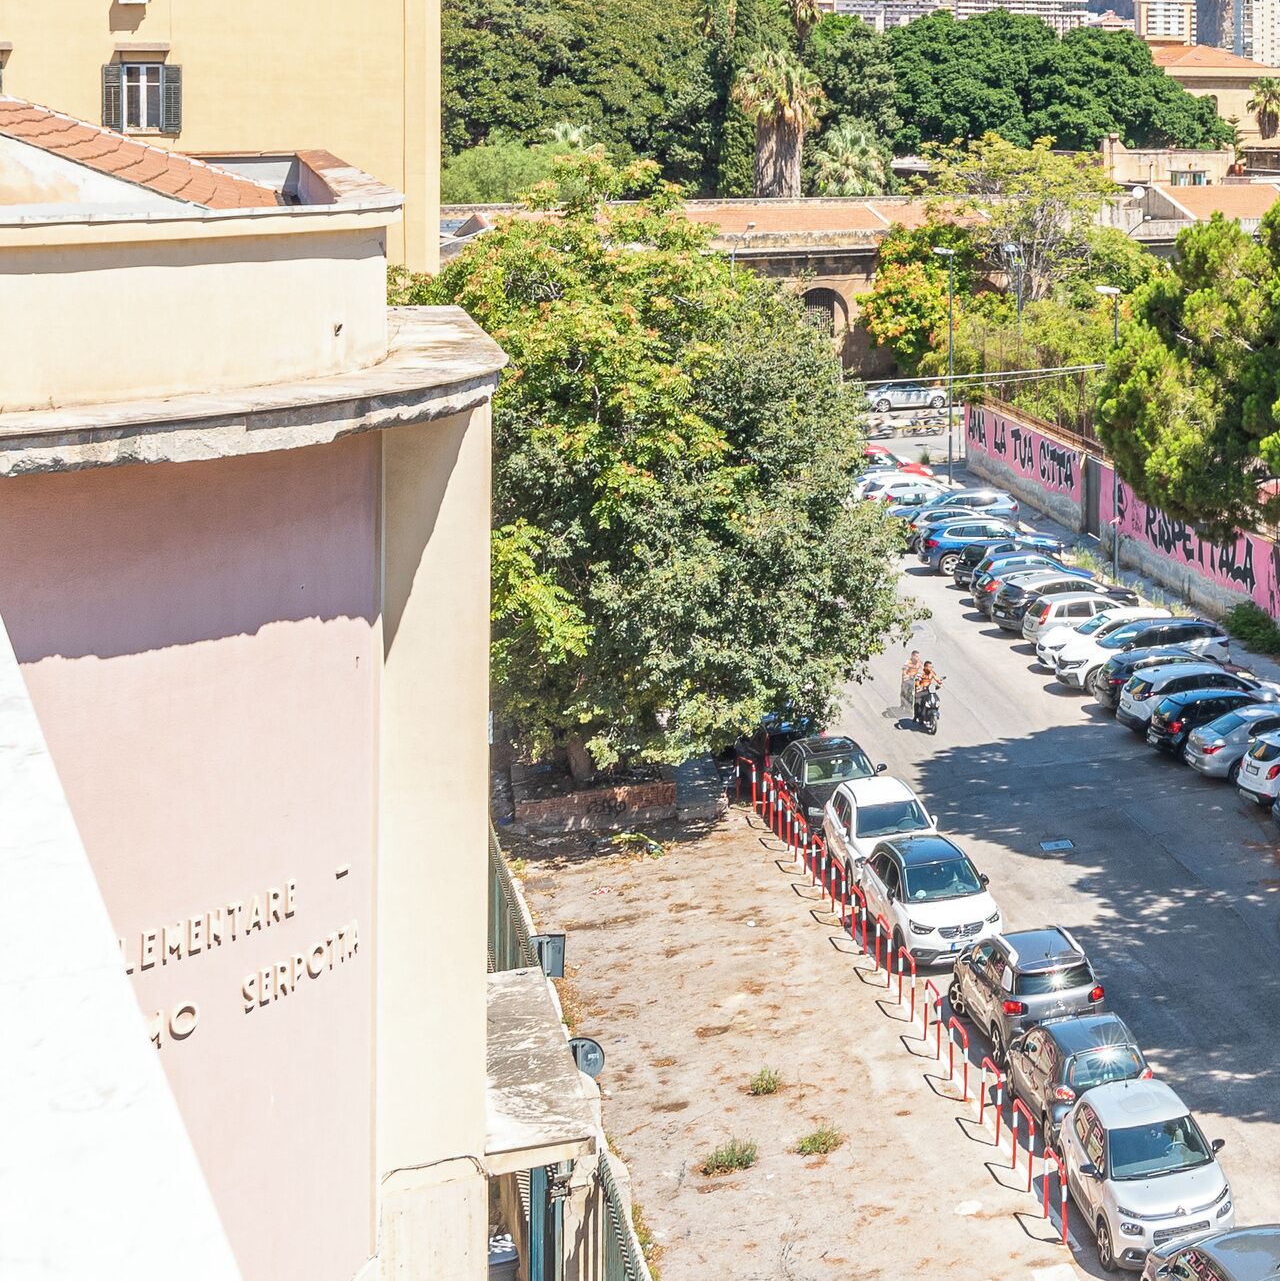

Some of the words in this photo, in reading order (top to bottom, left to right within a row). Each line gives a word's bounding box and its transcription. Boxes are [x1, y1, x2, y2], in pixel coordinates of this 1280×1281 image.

[968, 405, 988, 450] AMA
[993, 415, 1007, 457] LA
[1010, 426, 1034, 472] TUA
[241, 918, 360, 1015] SERPOTTA
